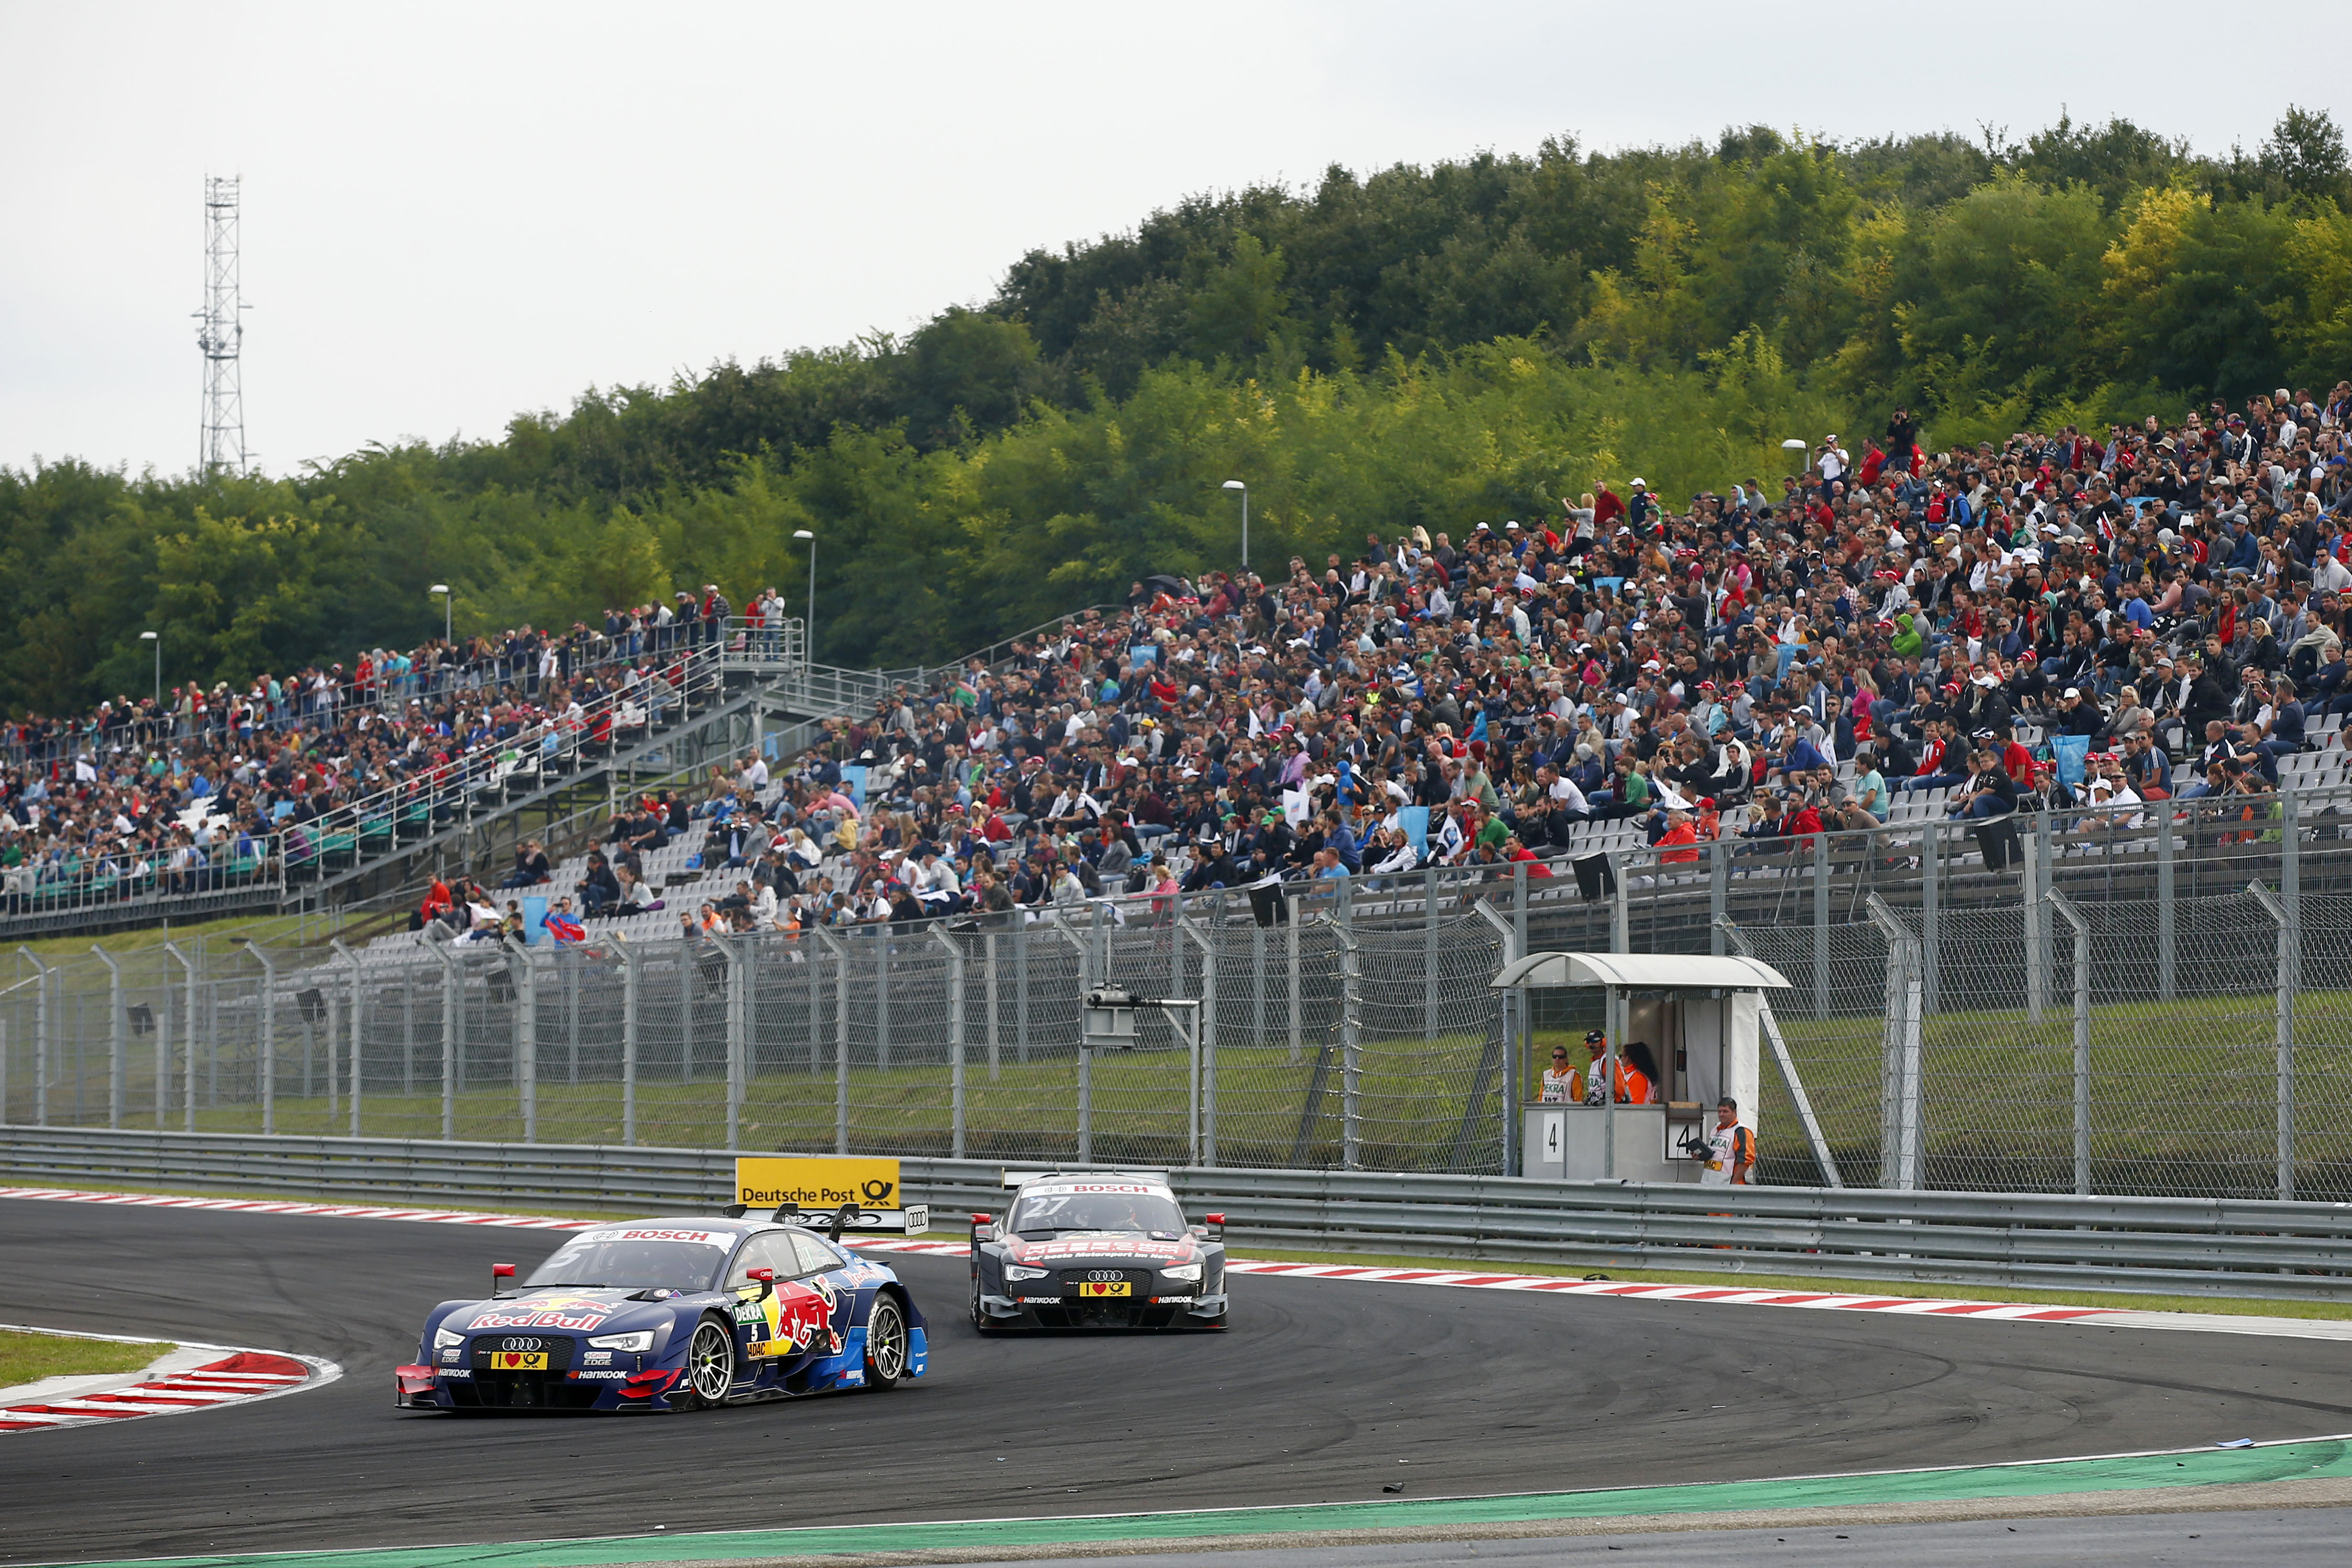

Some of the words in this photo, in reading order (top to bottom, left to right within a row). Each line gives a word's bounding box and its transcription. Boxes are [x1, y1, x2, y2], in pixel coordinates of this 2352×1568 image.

[1549, 1123, 1557, 1152] 4
[1676, 1125, 1689, 1154] 4
[743, 1188, 816, 1202] Deutsche
[822, 1188, 855, 1202] Post
[1021, 1196, 1071, 1219] 27
[621, 1231, 710, 1242] BOSCH
[546, 1244, 597, 1269] 5
[468, 1311, 534, 1330] Red
[531, 1312, 606, 1331] Bull
[734, 1304, 764, 1322] DEKRA
[751, 1324, 758, 1342] 5
[748, 1342, 766, 1357] ADAC
